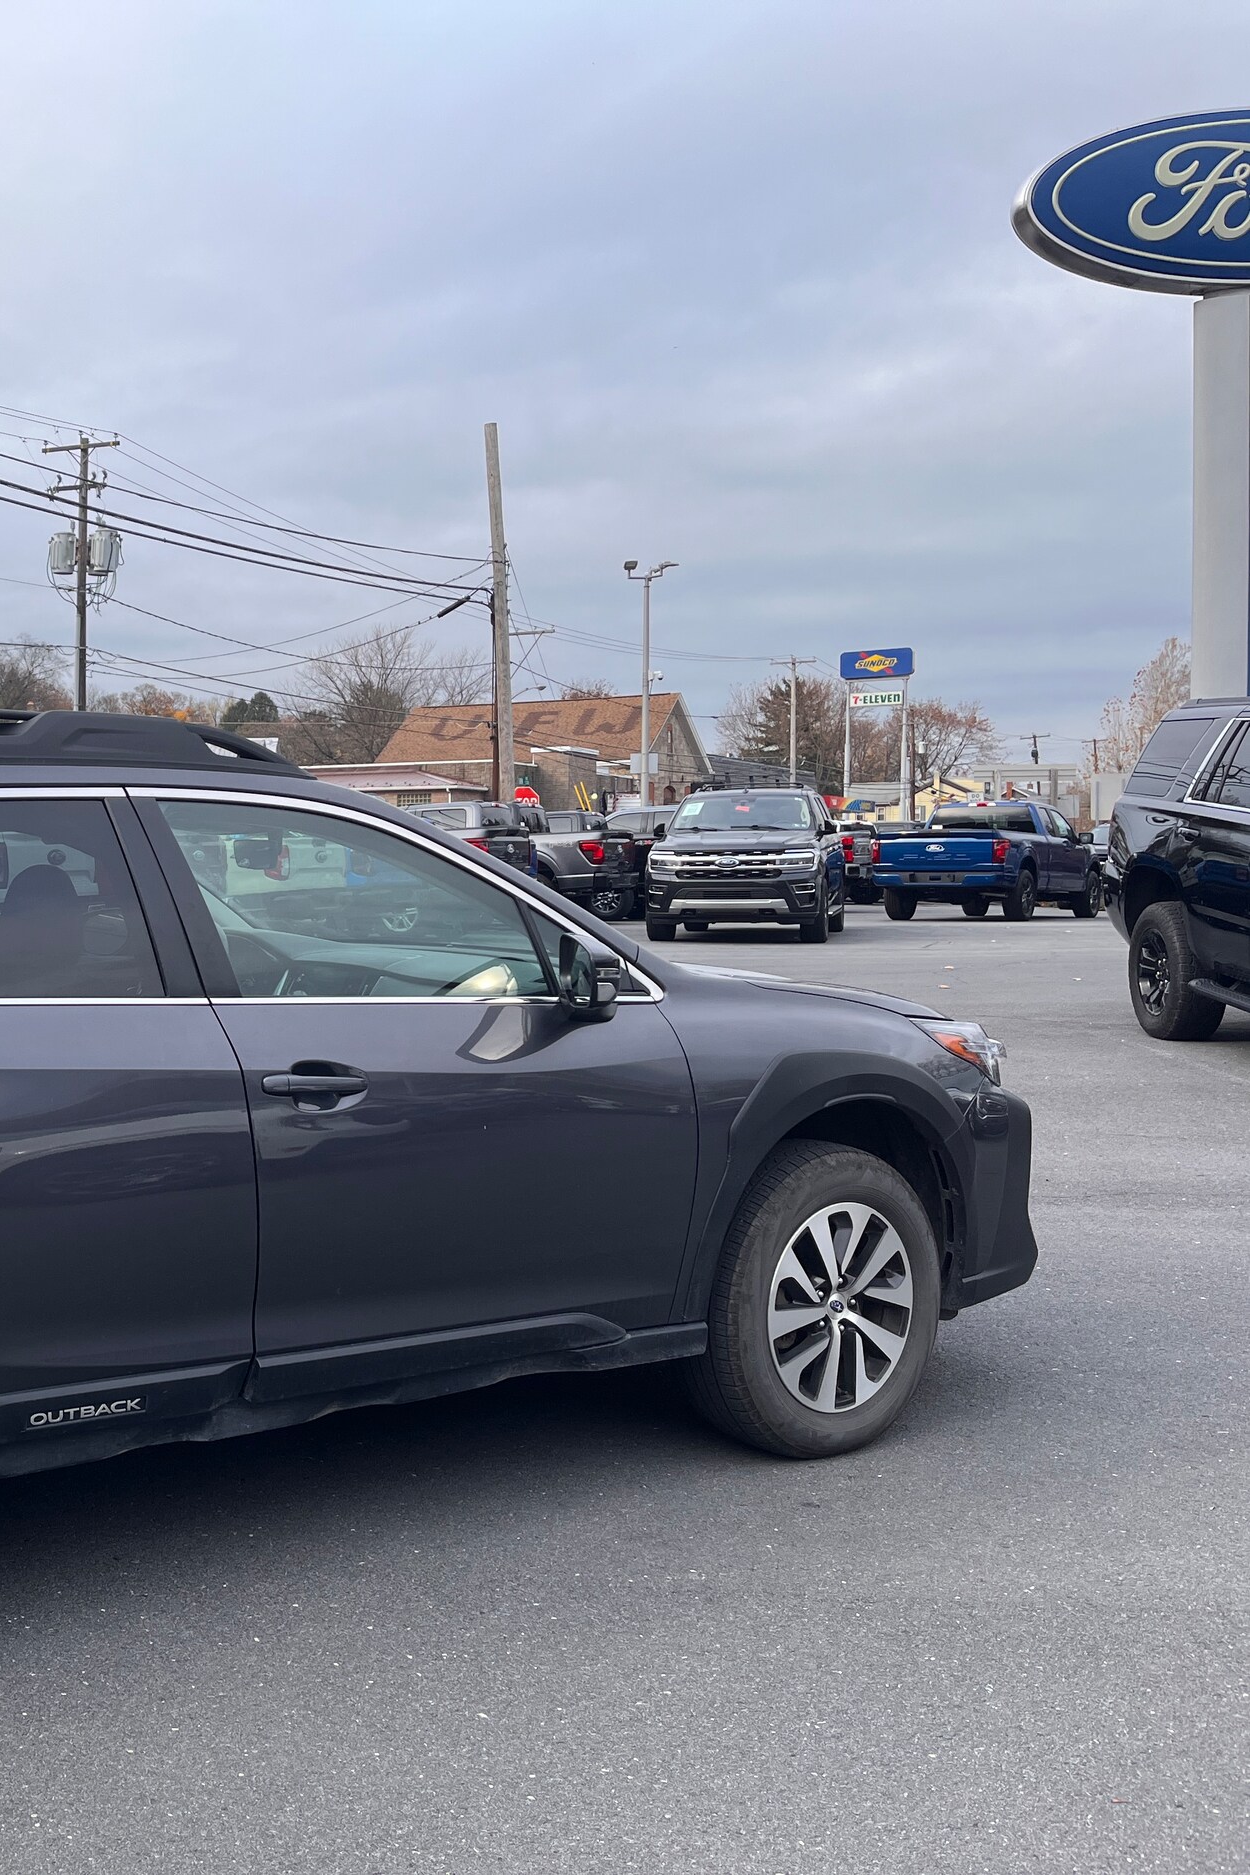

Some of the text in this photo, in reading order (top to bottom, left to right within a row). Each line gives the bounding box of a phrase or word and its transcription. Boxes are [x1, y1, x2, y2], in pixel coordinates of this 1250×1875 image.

[1127, 140, 1250, 242] Fo
[857, 658, 896, 668] SUNOCO
[29, 1397, 142, 1426] OUTBACK
